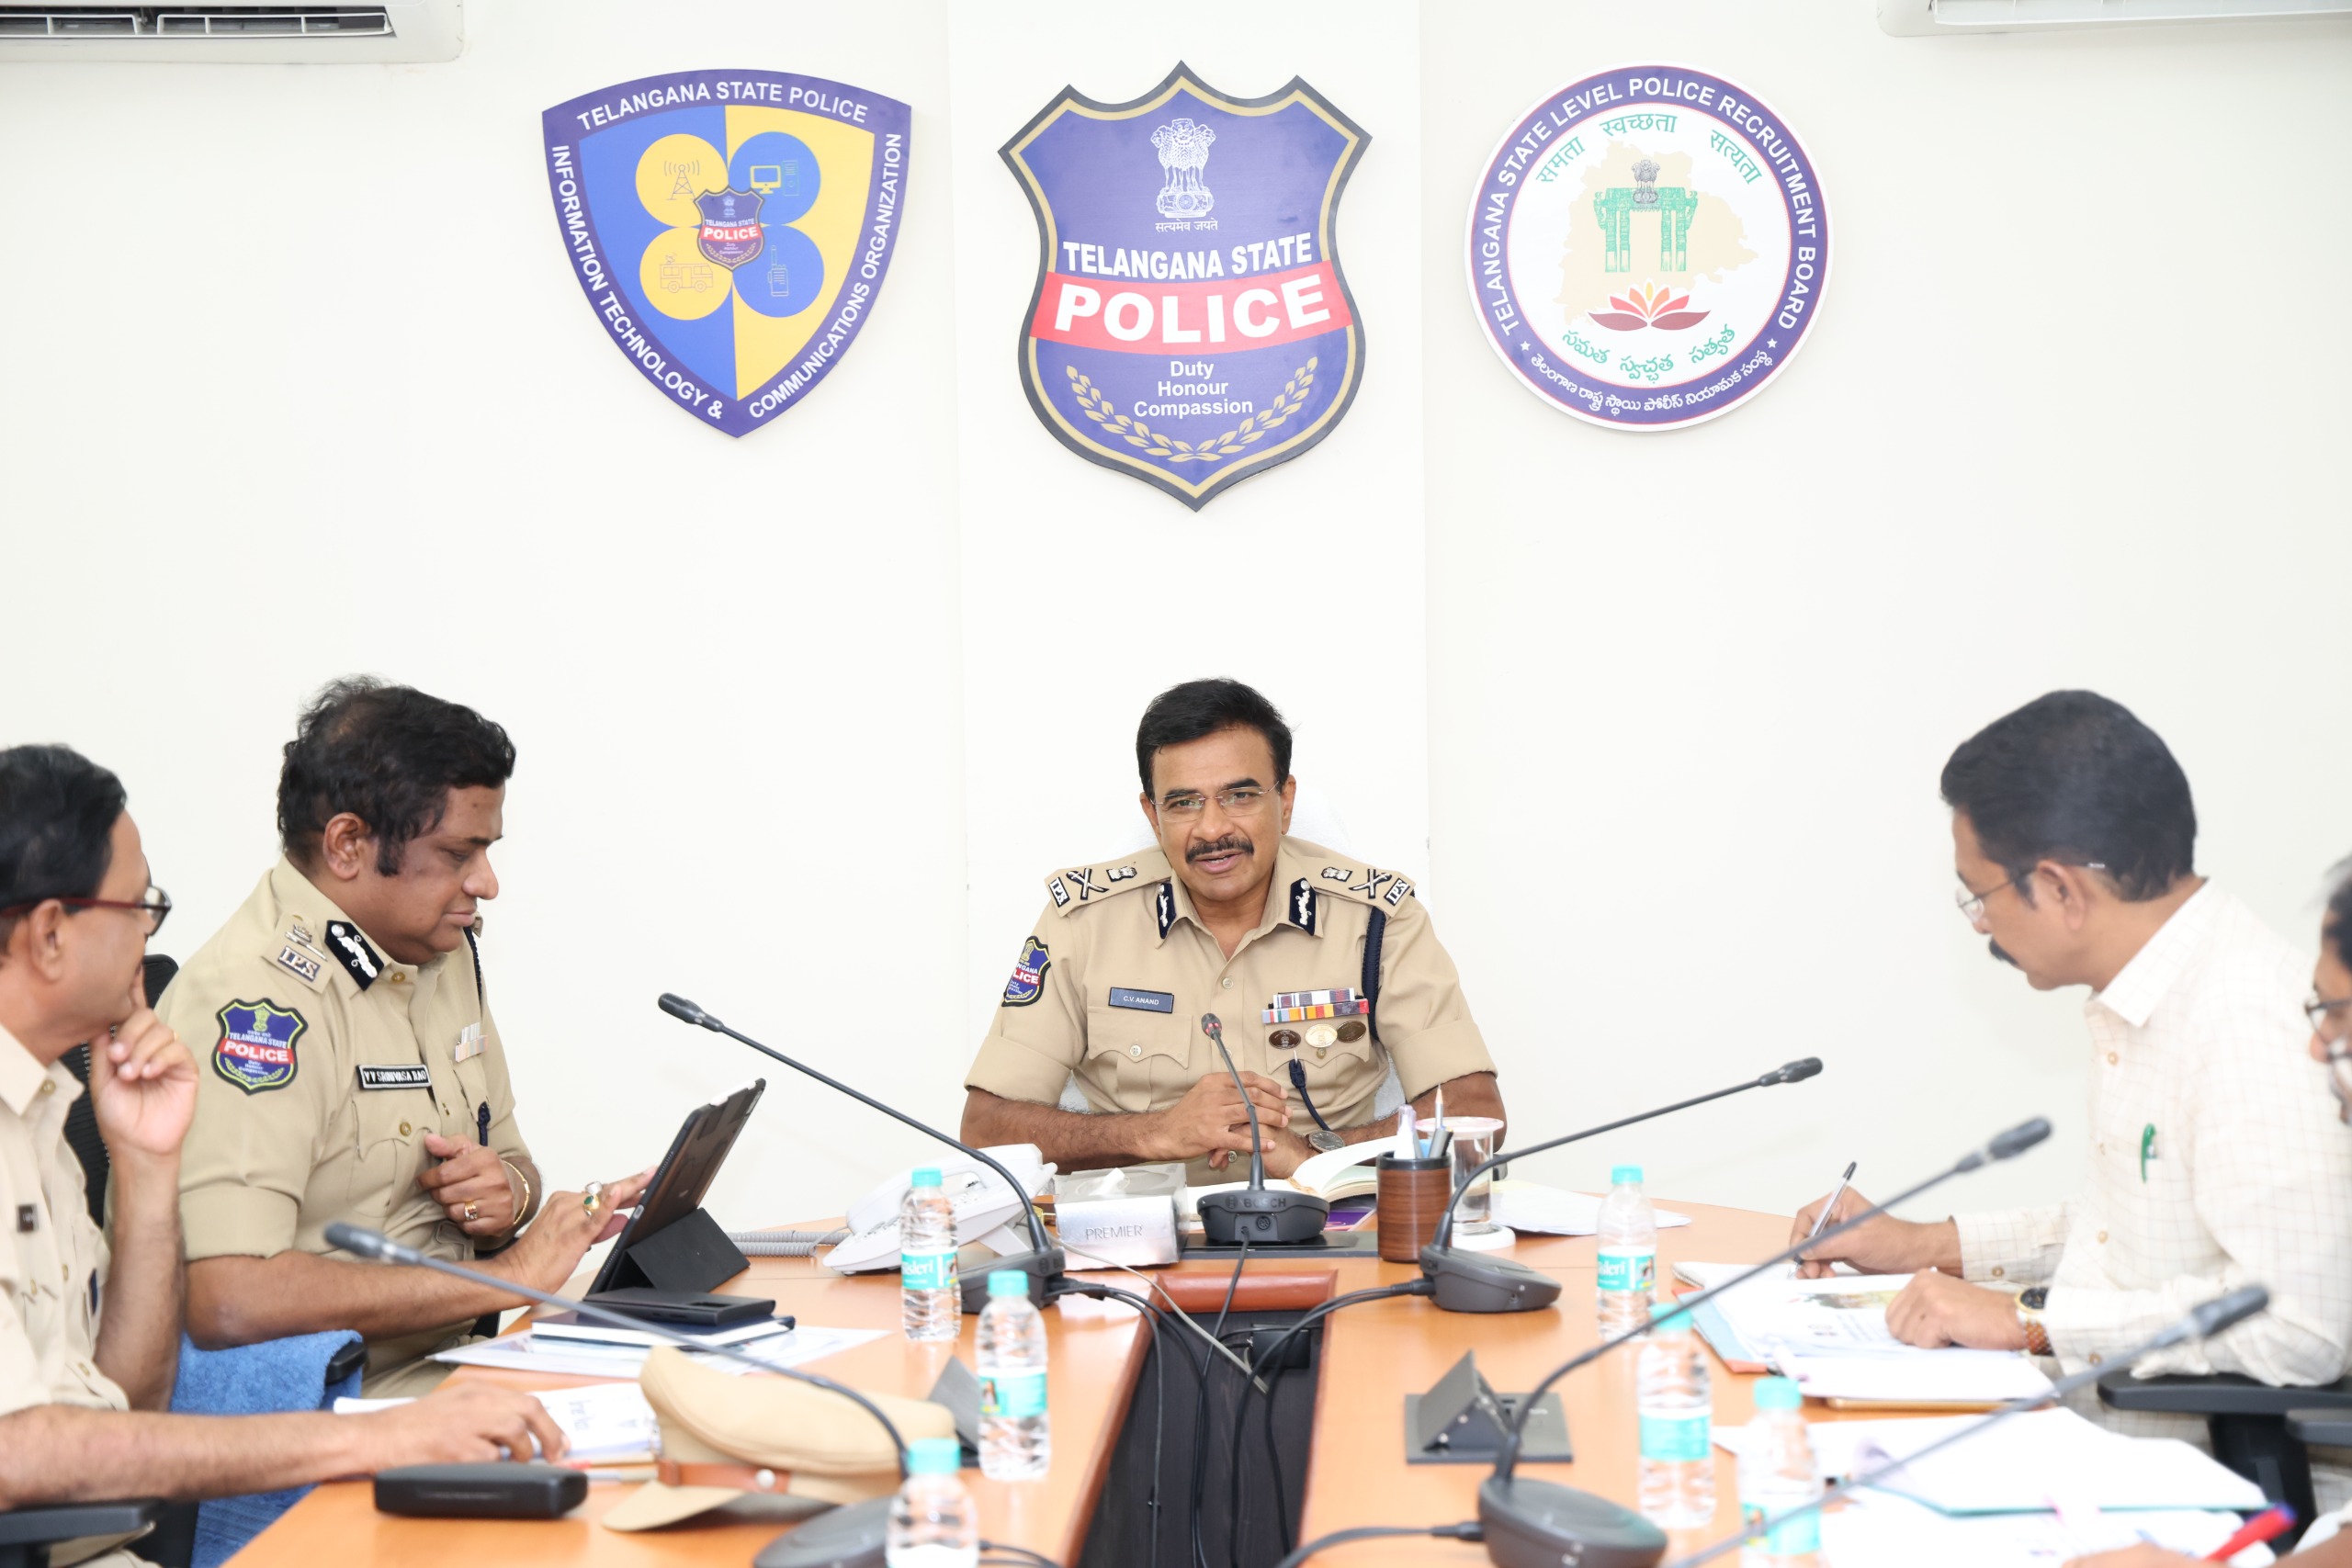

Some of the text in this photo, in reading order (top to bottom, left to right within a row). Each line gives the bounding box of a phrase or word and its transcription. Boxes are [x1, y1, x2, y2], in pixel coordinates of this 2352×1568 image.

[577, 82, 868, 130] TELANGANA STATE POLICE
[1535, 113, 1762, 185] समता स्वच्छता सत्यता
[1483, 76, 1816, 336] TELANGANA STATE LEVEL POLICE RECRUITMENT BOARD
[705, 218, 754, 228] TELANGANA STATE
[1155, 217, 1218, 233] सत्यमेव जयते
[704, 227, 758, 240] POLICE
[1063, 232, 1312, 280] TELANGANA STATE
[552, 145, 723, 420] INFORMATION TECHNOLOGY &
[749, 133, 902, 419] COMMUNICATIONS ORGANIZATION
[1054, 274, 1331, 344] POLICE
[1562, 330, 1611, 364] సమత
[1689, 324, 1736, 364] సత్యత
[1170, 361, 1214, 379] Duty
[1158, 379, 1229, 397] Honour
[1531, 353, 1577, 393] తెలంగాణ
[1644, 393, 1683, 411] పోలీస్
[1685, 371, 1743, 404] నియామక
[1134, 399, 1253, 419] Compassion
[1012, 969, 1039, 985] LICE
[1016, 963, 1038, 975] NGANA
[229, 1032, 267, 1044] TELANGANA
[268, 1038, 288, 1049] STATE
[223, 1041, 289, 1062] POLICE
[1244, 1197, 1286, 1209] BOSCH
[1085, 1224, 1143, 1240] PREMIER
